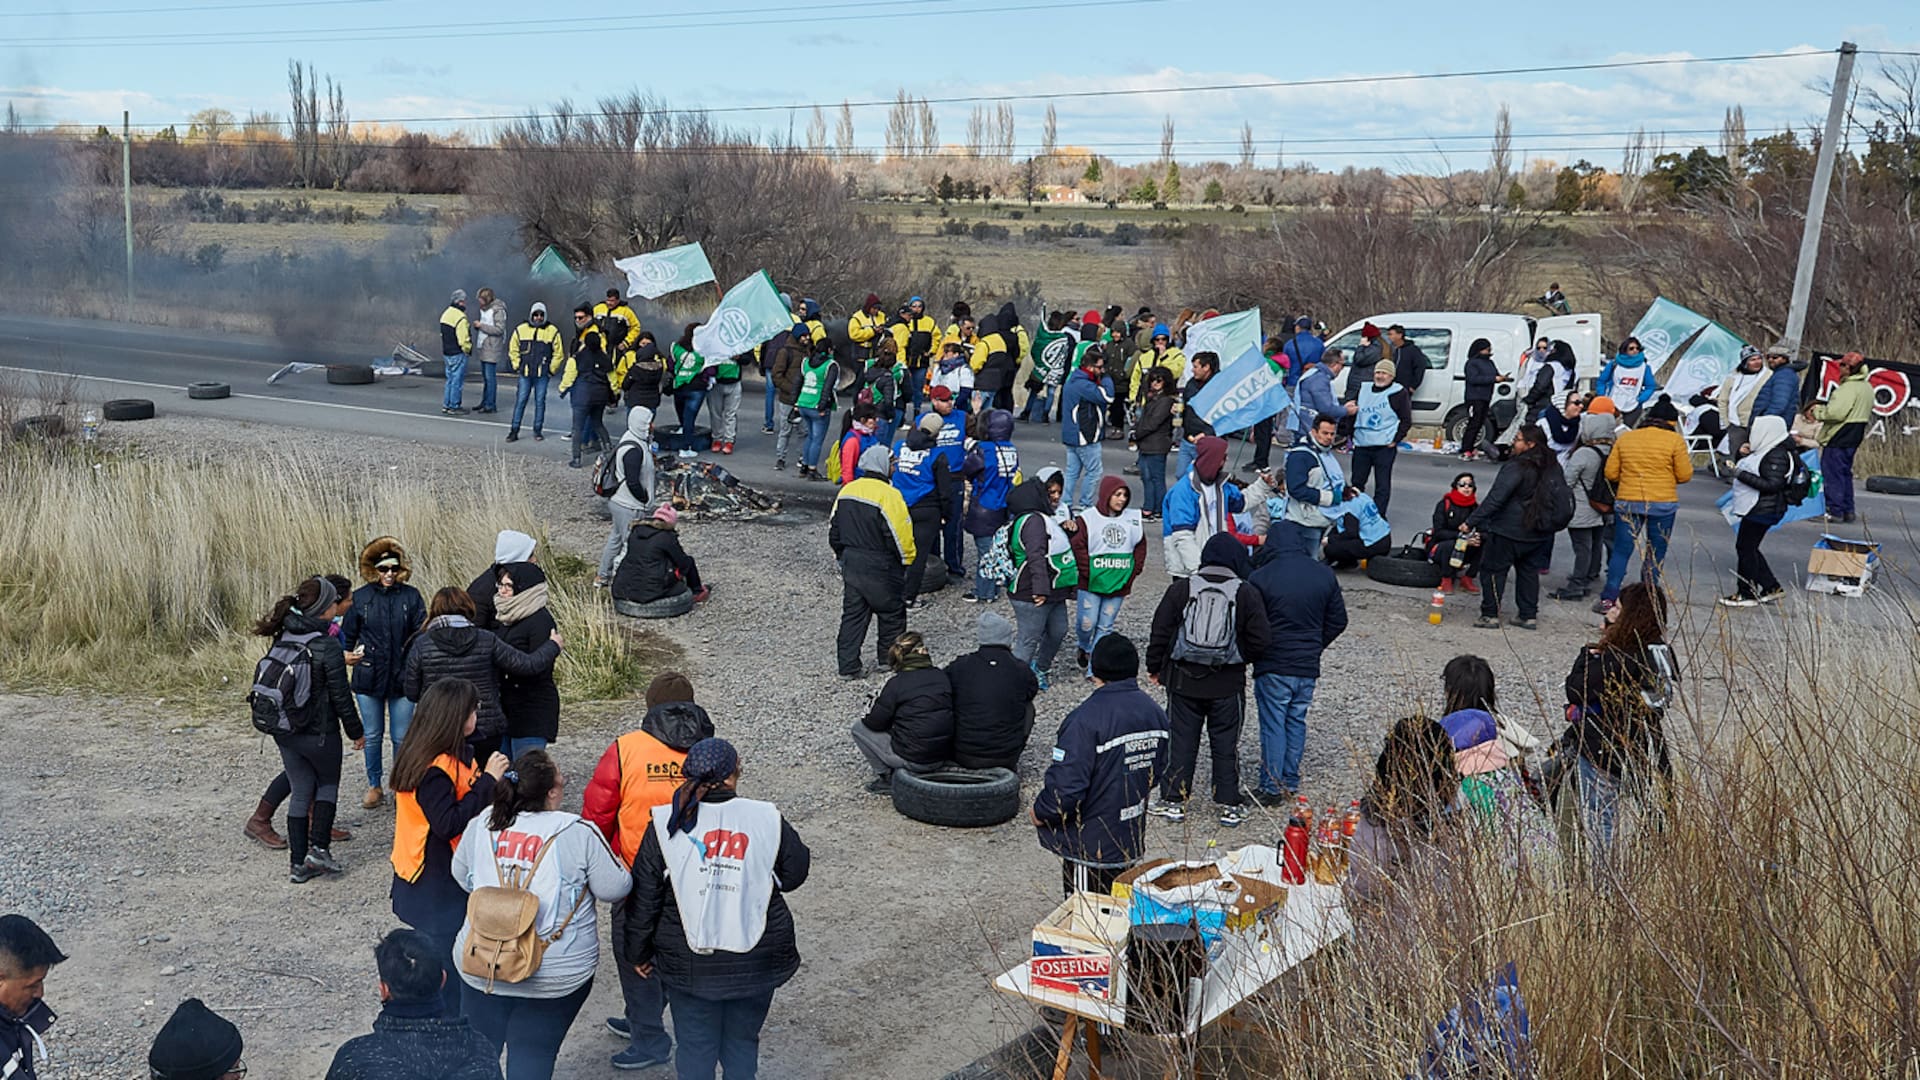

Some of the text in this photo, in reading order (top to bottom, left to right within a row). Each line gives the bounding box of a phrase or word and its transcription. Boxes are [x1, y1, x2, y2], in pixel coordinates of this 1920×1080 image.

[1124, 738, 1159, 754] INSPECTR
[703, 828, 749, 861] CTA
[1034, 959, 1107, 977] JOSEFINA
